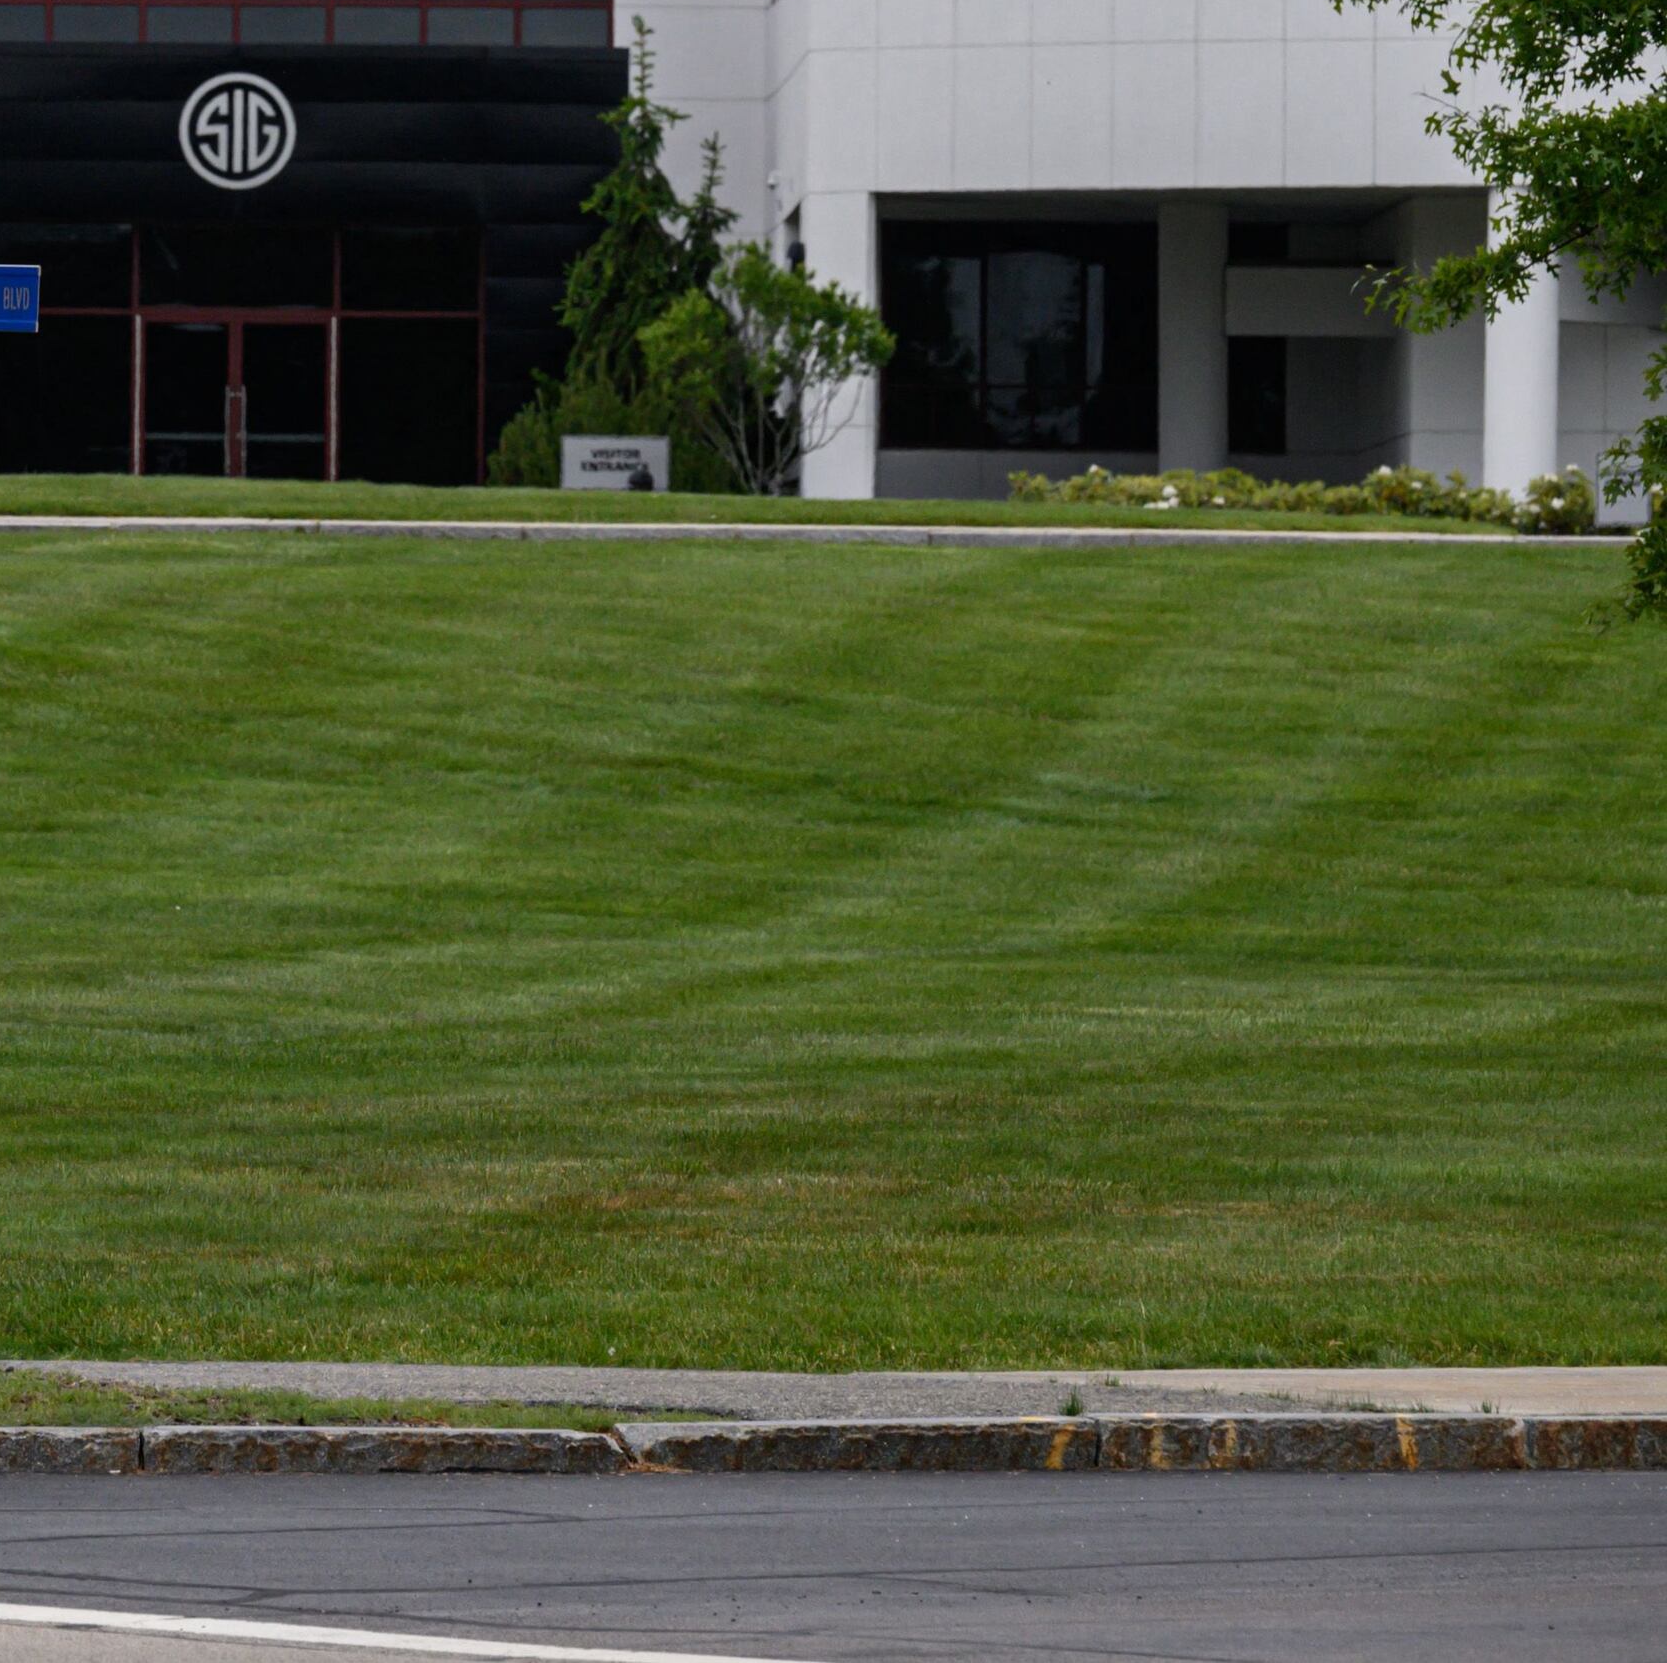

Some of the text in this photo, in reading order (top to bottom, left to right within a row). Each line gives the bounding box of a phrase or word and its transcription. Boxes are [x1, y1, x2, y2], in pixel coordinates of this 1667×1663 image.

[196, 88, 280, 173] SIG
[3, 286, 30, 310] BLVD
[590, 448, 641, 458] VISITOR
